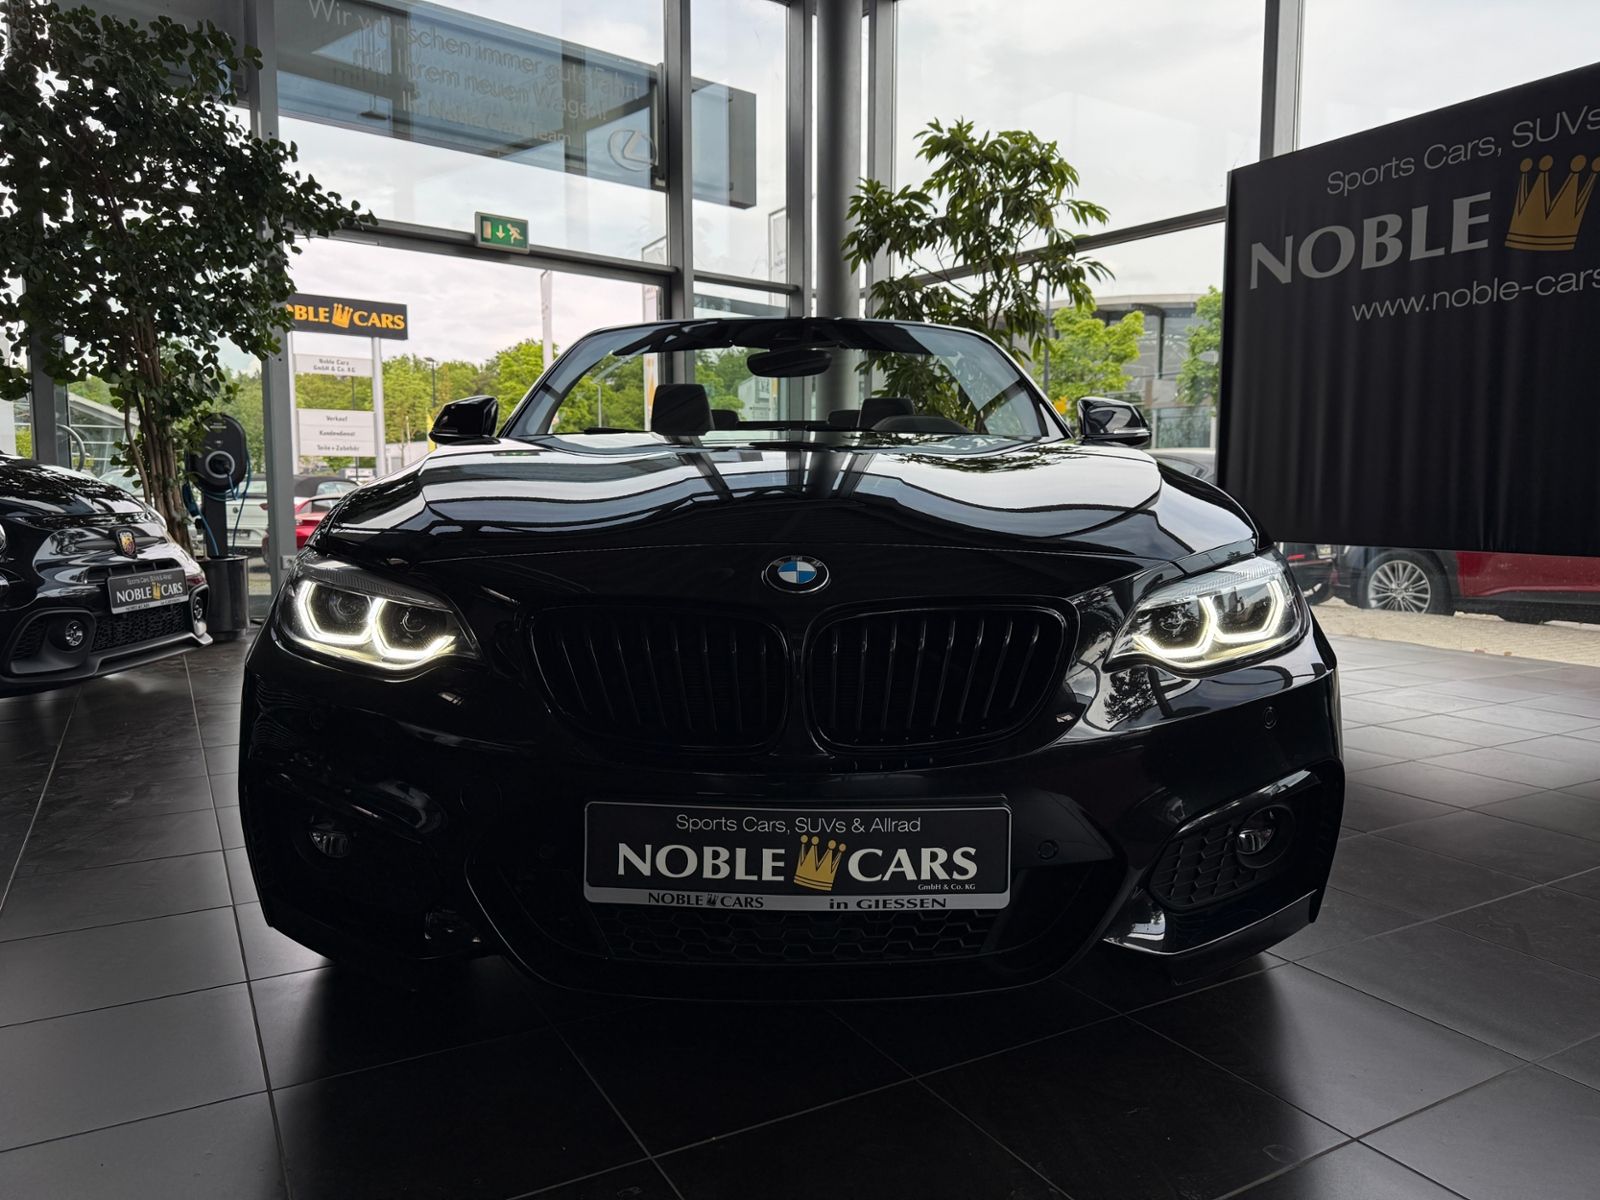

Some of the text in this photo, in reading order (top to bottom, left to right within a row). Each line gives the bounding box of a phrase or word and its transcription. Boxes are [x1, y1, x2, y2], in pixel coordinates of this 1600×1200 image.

[476, 40, 543, 74] immer
[1327, 105, 1600, 197] Sports Cars, SUVs
[1249, 191, 1491, 290] NOBLE
[353, 310, 405, 330] CARS
[116, 586, 152, 604] NOBLE
[161, 582, 184, 597] CARS
[675, 813, 922, 835] Sports Cars, SUVs & Allrad
[617, 842, 978, 882] NOBLE CARS
[918, 883, 976, 891] GmbH & Co. KG
[648, 892, 764, 909] NOBLE CARS
[829, 898, 947, 910] in GIESSEN
